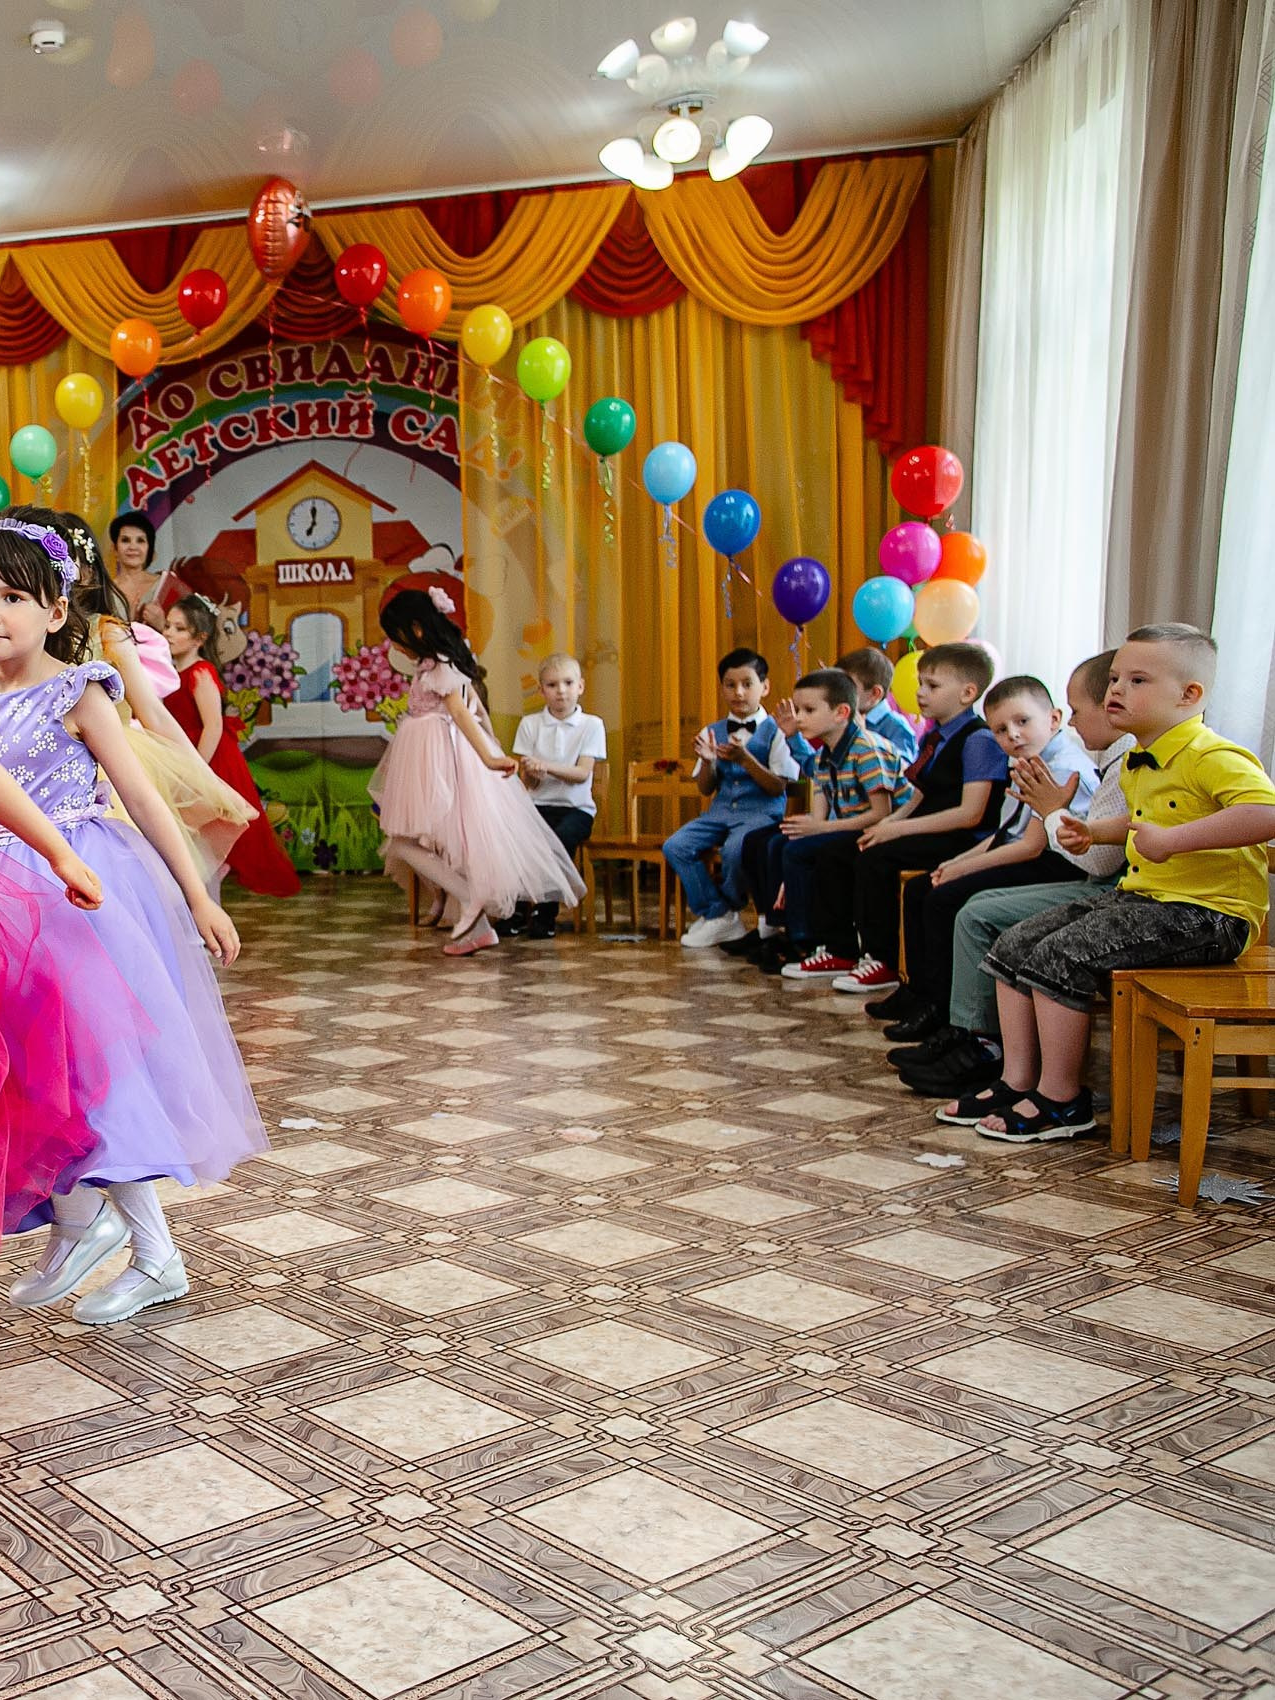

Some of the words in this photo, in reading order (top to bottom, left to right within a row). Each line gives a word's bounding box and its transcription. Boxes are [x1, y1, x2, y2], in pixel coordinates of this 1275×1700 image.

[125, 390, 375, 508] ДЕТСКИЙ
[128, 382, 196, 452] ДО
[277, 561, 353, 584] ШКОЛА
